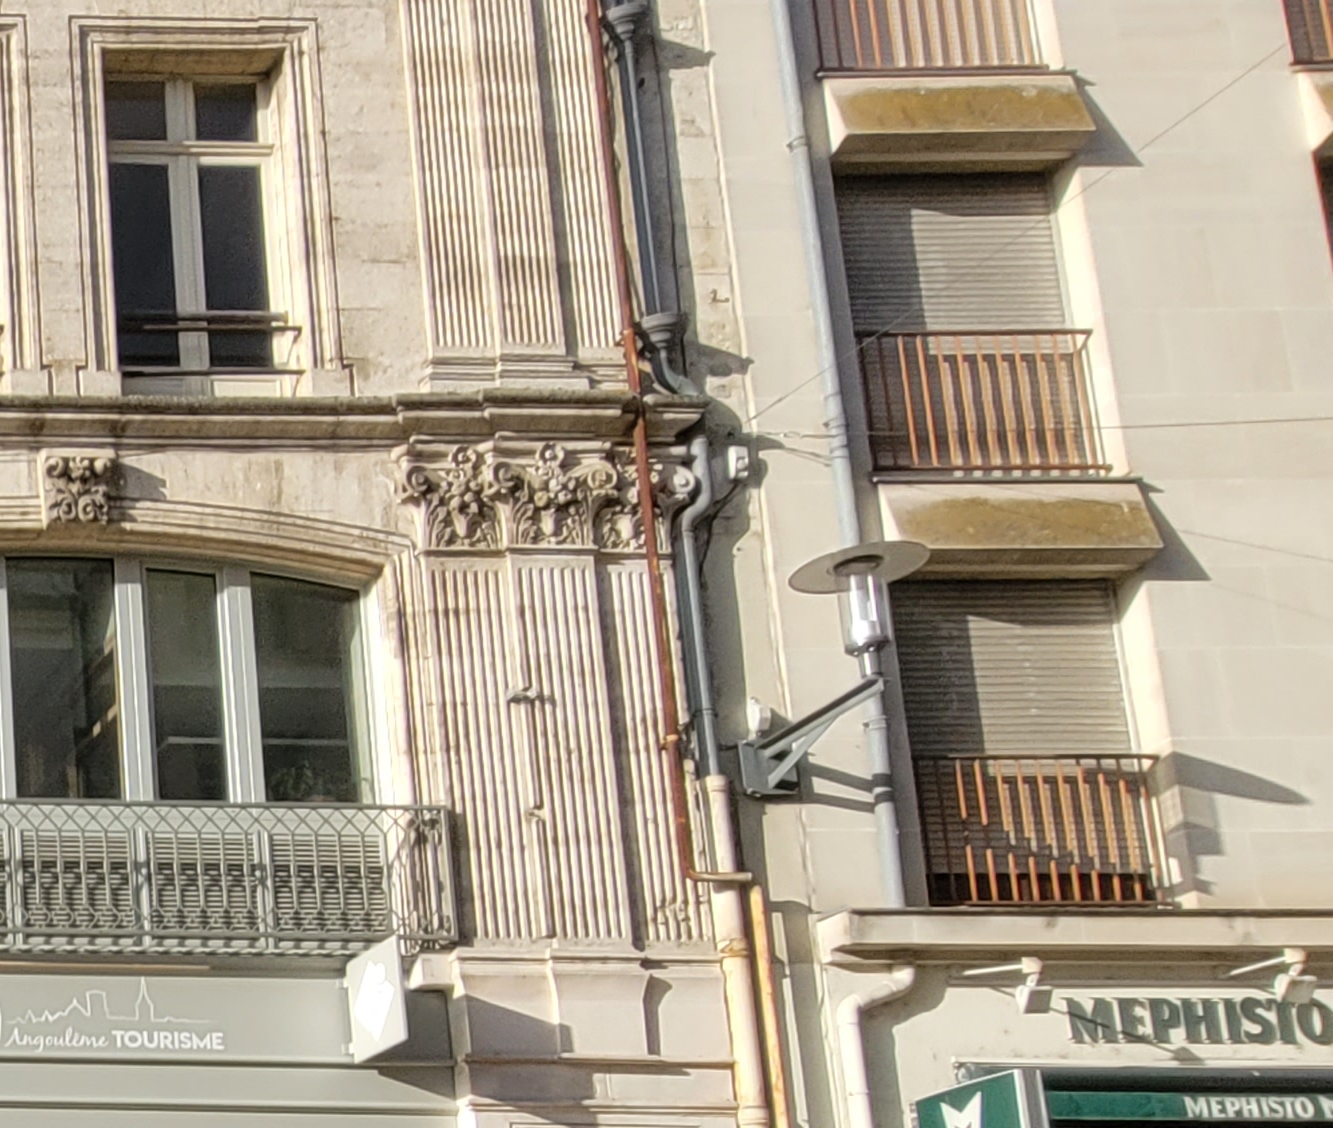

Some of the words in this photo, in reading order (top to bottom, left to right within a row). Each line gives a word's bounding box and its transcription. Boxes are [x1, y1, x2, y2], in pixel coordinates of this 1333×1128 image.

[1060, 997, 1333, 1046] MEPHISTO
[112, 1030, 225, 1050] TOURISME
[1183, 1096, 1315, 1119] MEPHISTO
